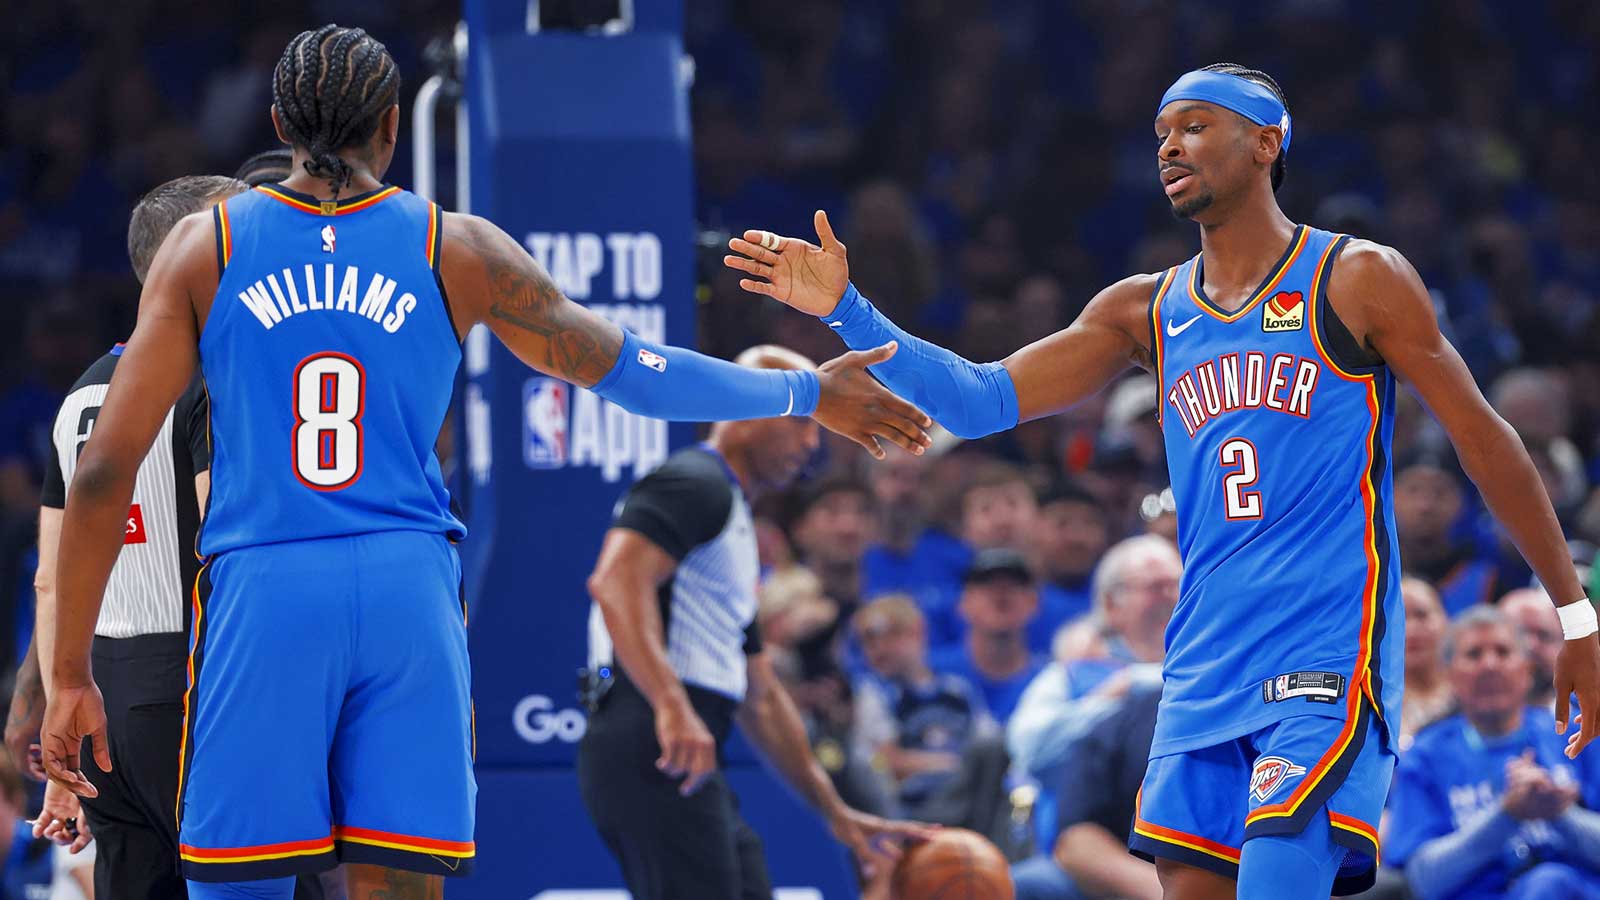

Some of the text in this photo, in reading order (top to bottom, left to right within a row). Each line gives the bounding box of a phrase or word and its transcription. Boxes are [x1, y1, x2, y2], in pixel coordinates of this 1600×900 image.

[238, 263, 417, 333] WILLIAMS
[525, 232, 663, 300] TAP TO
[291, 351, 366, 492] 8
[1168, 352, 1320, 439] THUNDER
[1219, 437, 1263, 521] 2
